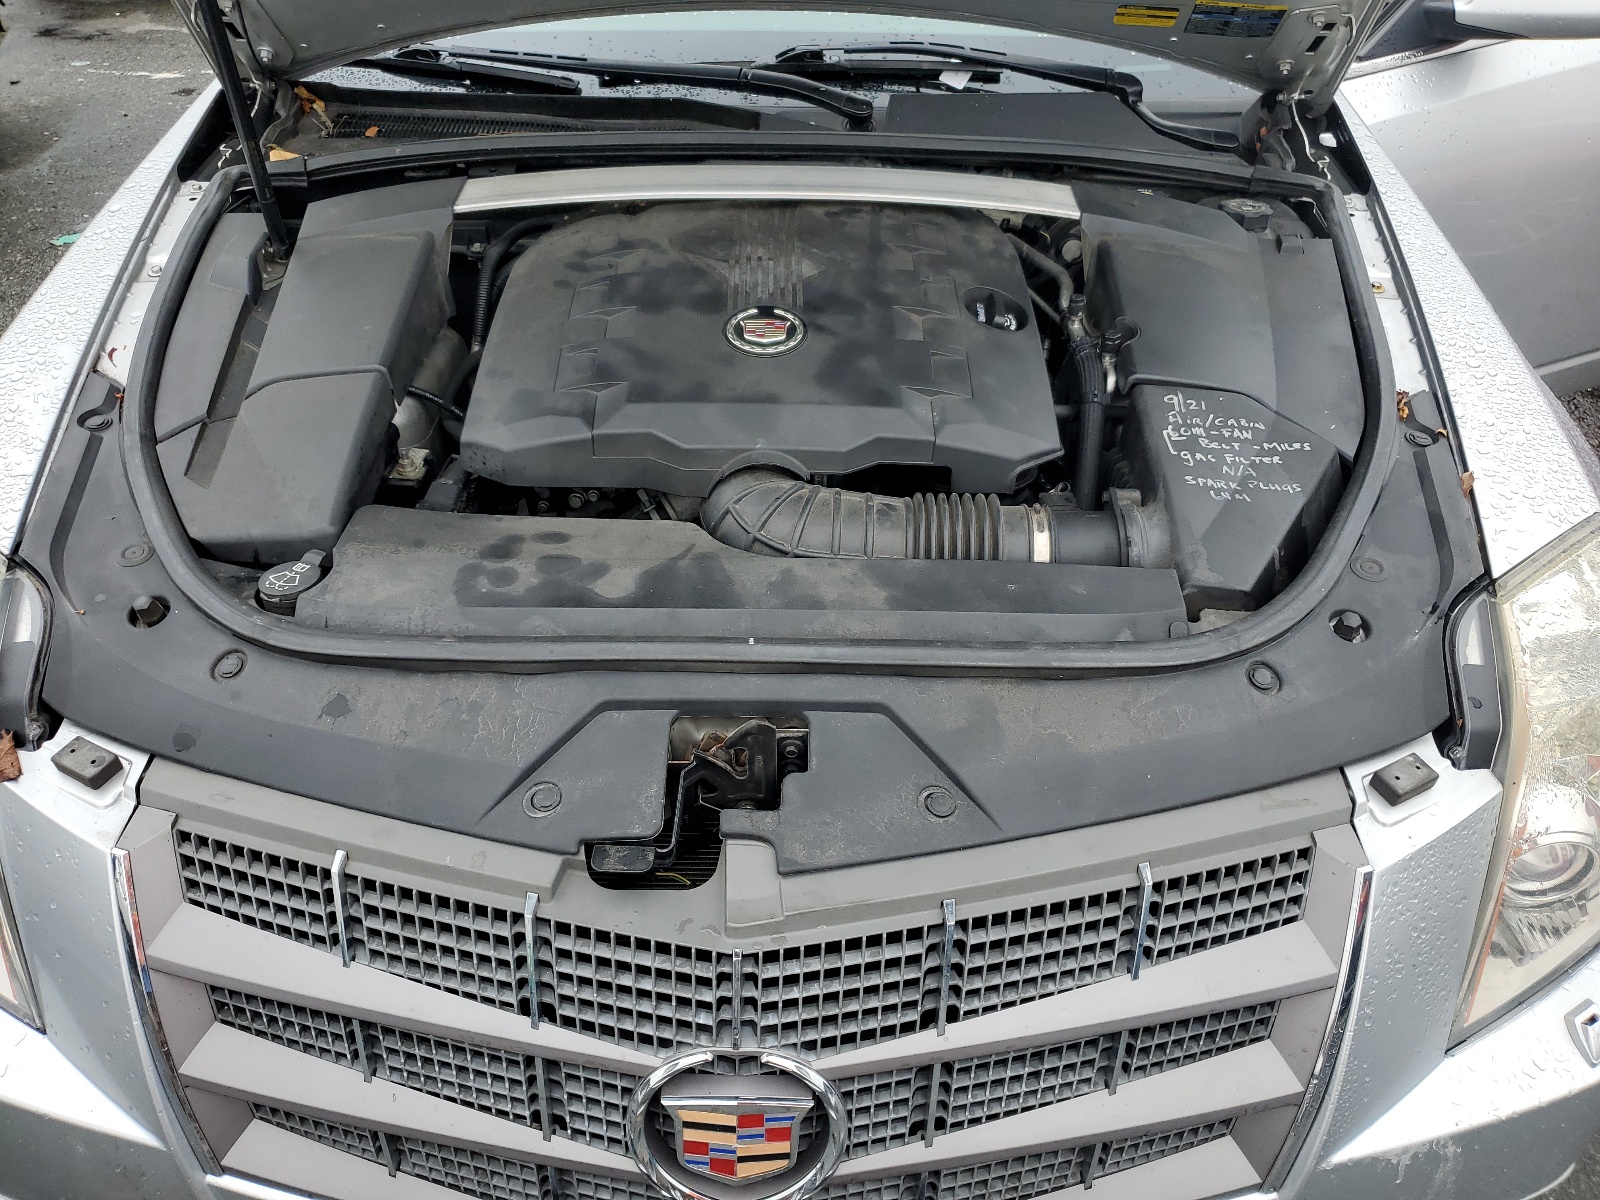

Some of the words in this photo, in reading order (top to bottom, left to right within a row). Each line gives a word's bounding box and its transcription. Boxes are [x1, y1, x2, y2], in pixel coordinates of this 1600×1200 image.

[1163, 390, 1206, 413] 9/21
[1222, 464, 1257, 477] N/A
[1184, 475, 1242, 490] SPARK
